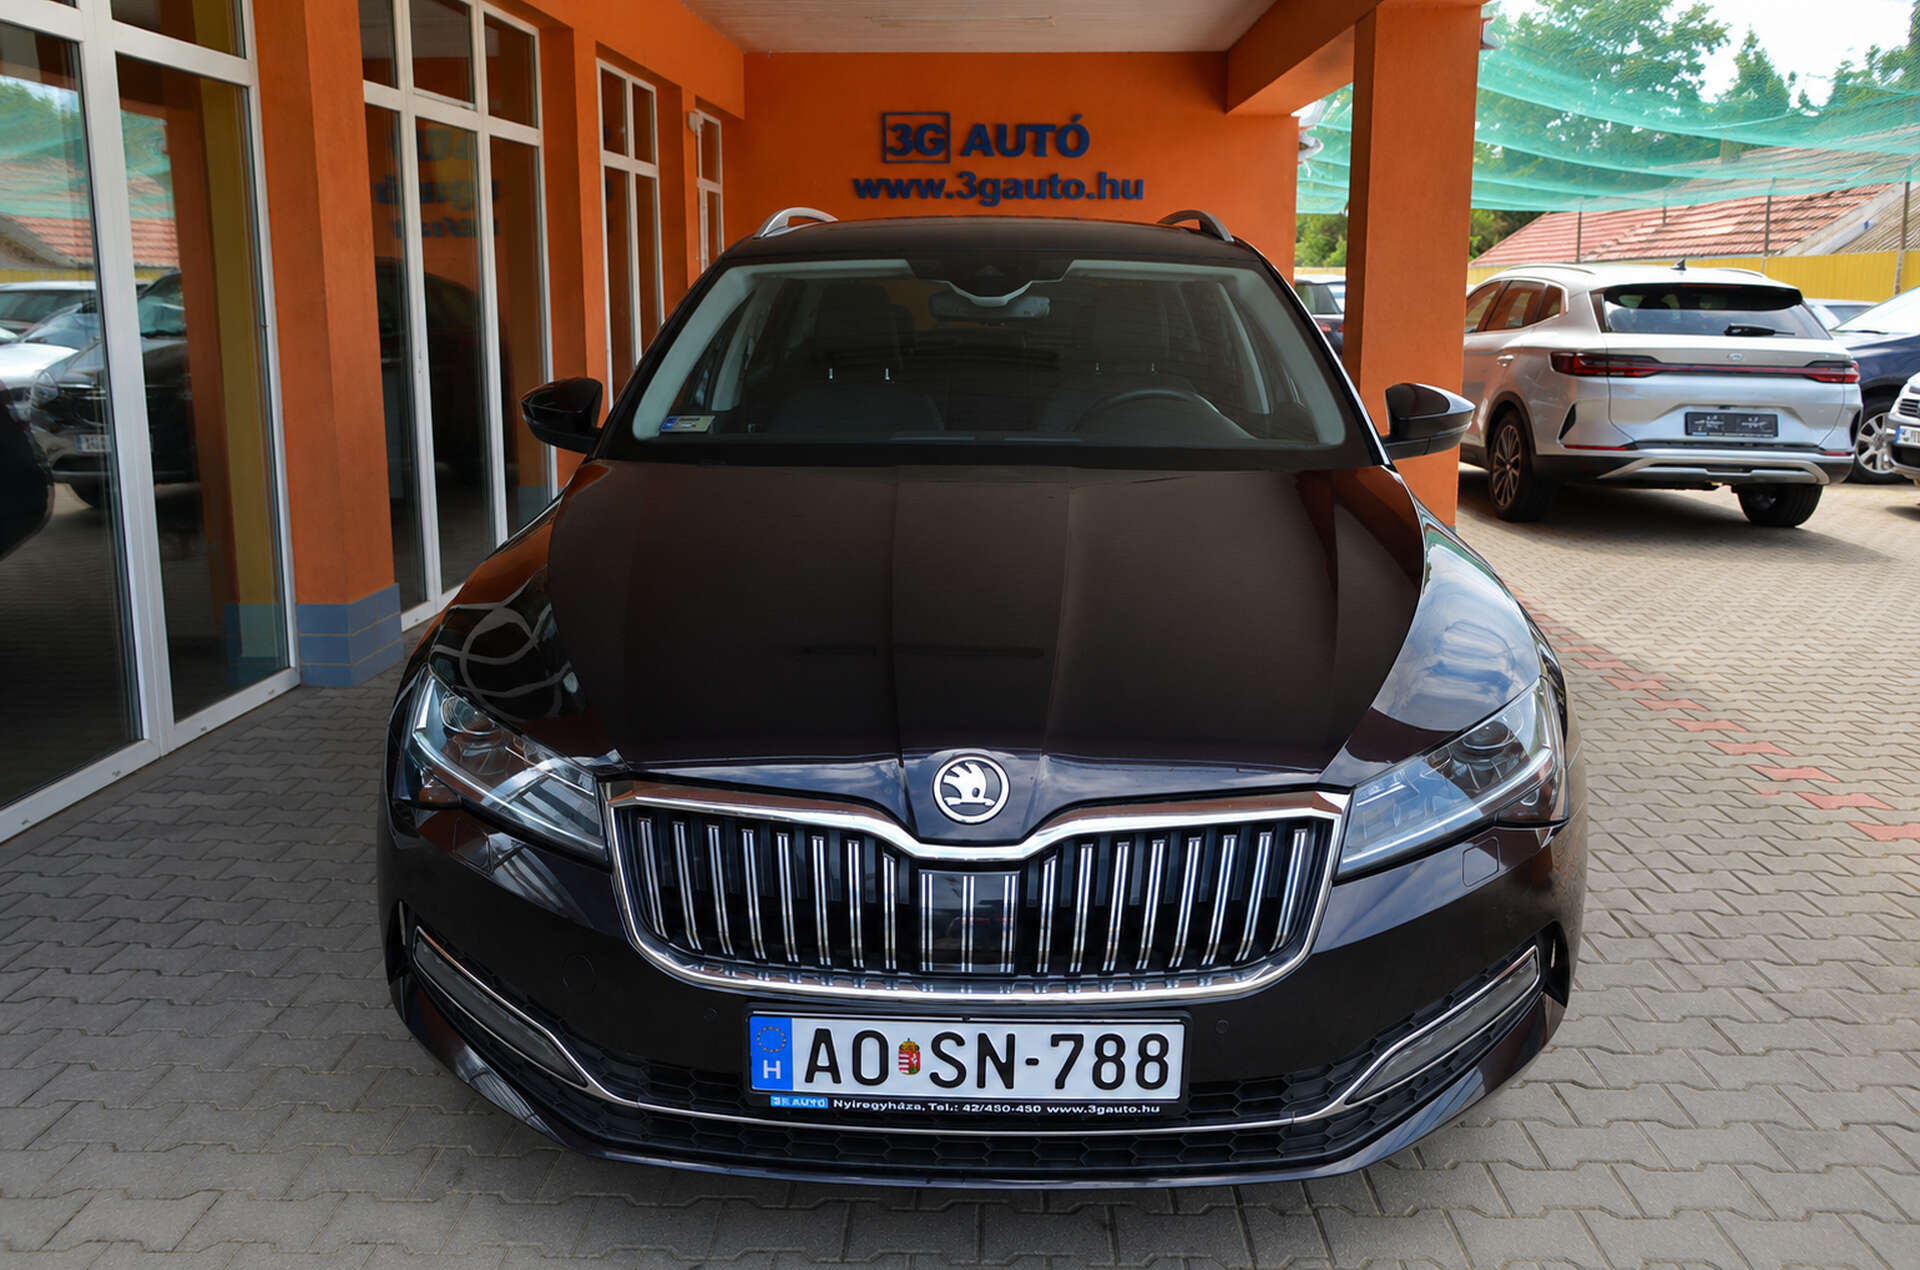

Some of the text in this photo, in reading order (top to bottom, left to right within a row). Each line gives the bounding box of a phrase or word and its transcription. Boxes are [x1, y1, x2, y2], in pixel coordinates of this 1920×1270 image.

[887, 114, 1091, 157] 3G AUTÓ
[852, 171, 1144, 207] www.3gauto.hu
[763, 1060, 781, 1080] H
[1047, 1104, 1160, 1115] www.3gauto.hu
